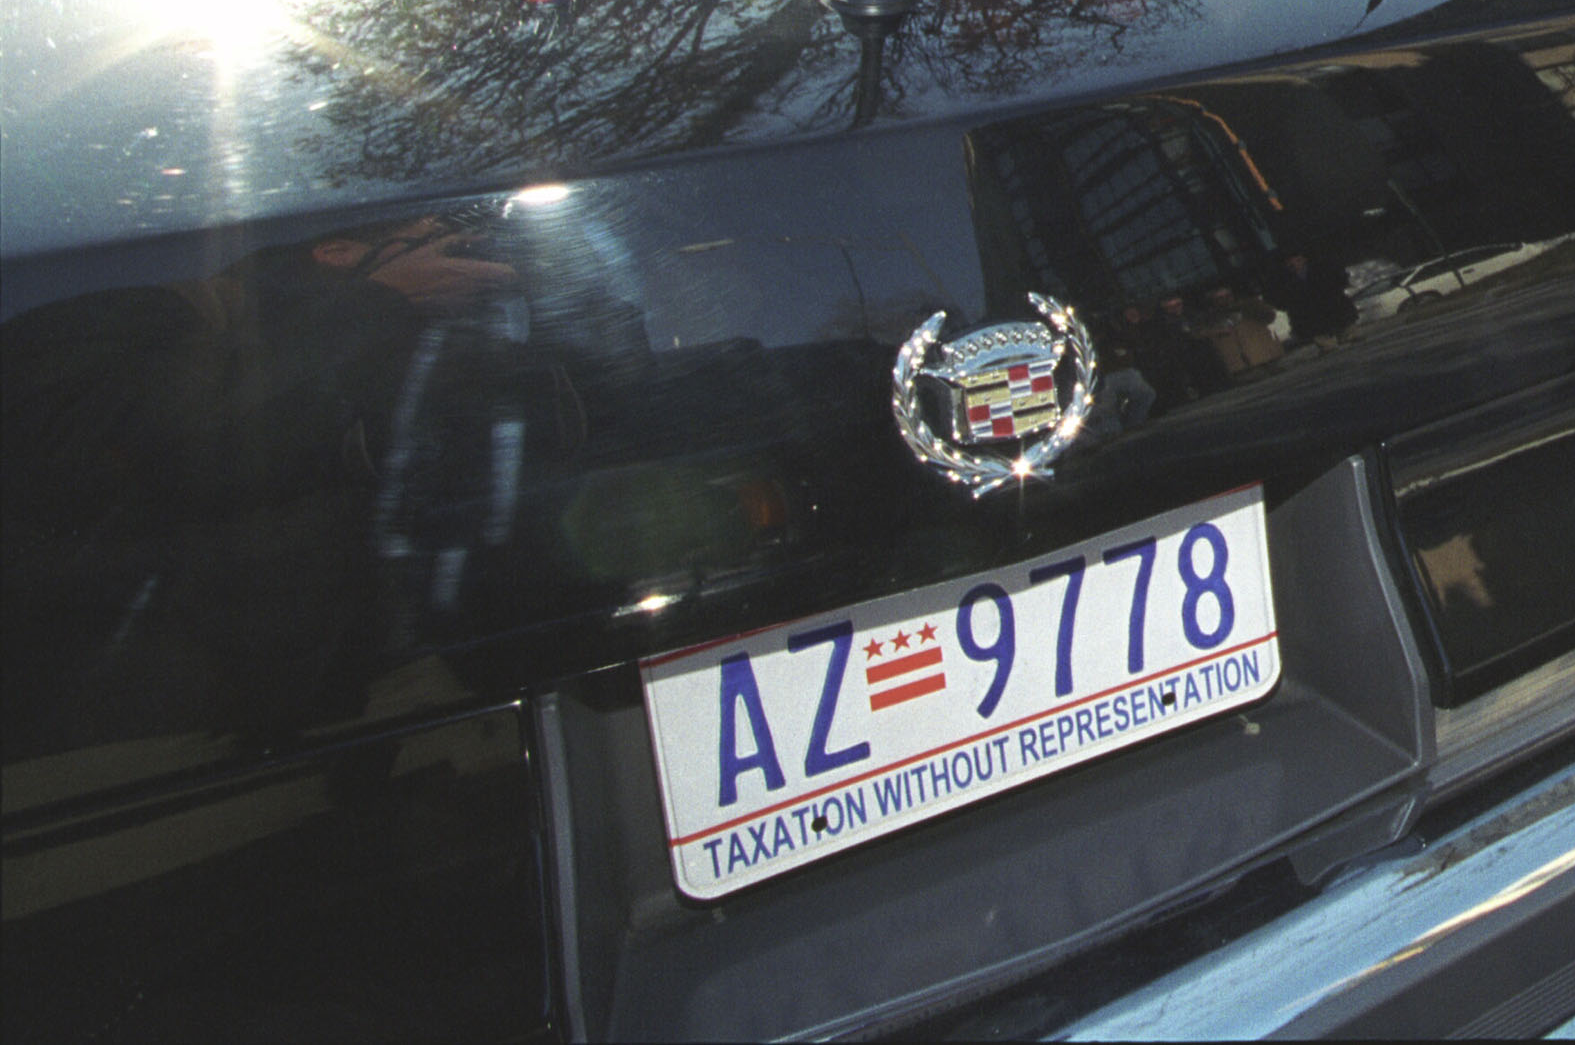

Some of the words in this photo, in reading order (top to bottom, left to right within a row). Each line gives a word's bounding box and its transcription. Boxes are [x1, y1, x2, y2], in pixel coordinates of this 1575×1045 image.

[703, 787, 868, 879] TAXATION
[873, 736, 1010, 817] WITHOUT
[1018, 649, 1261, 766] REPRESENTATION
[718, 620, 871, 808] AZ
[956, 522, 1236, 719] 9778
